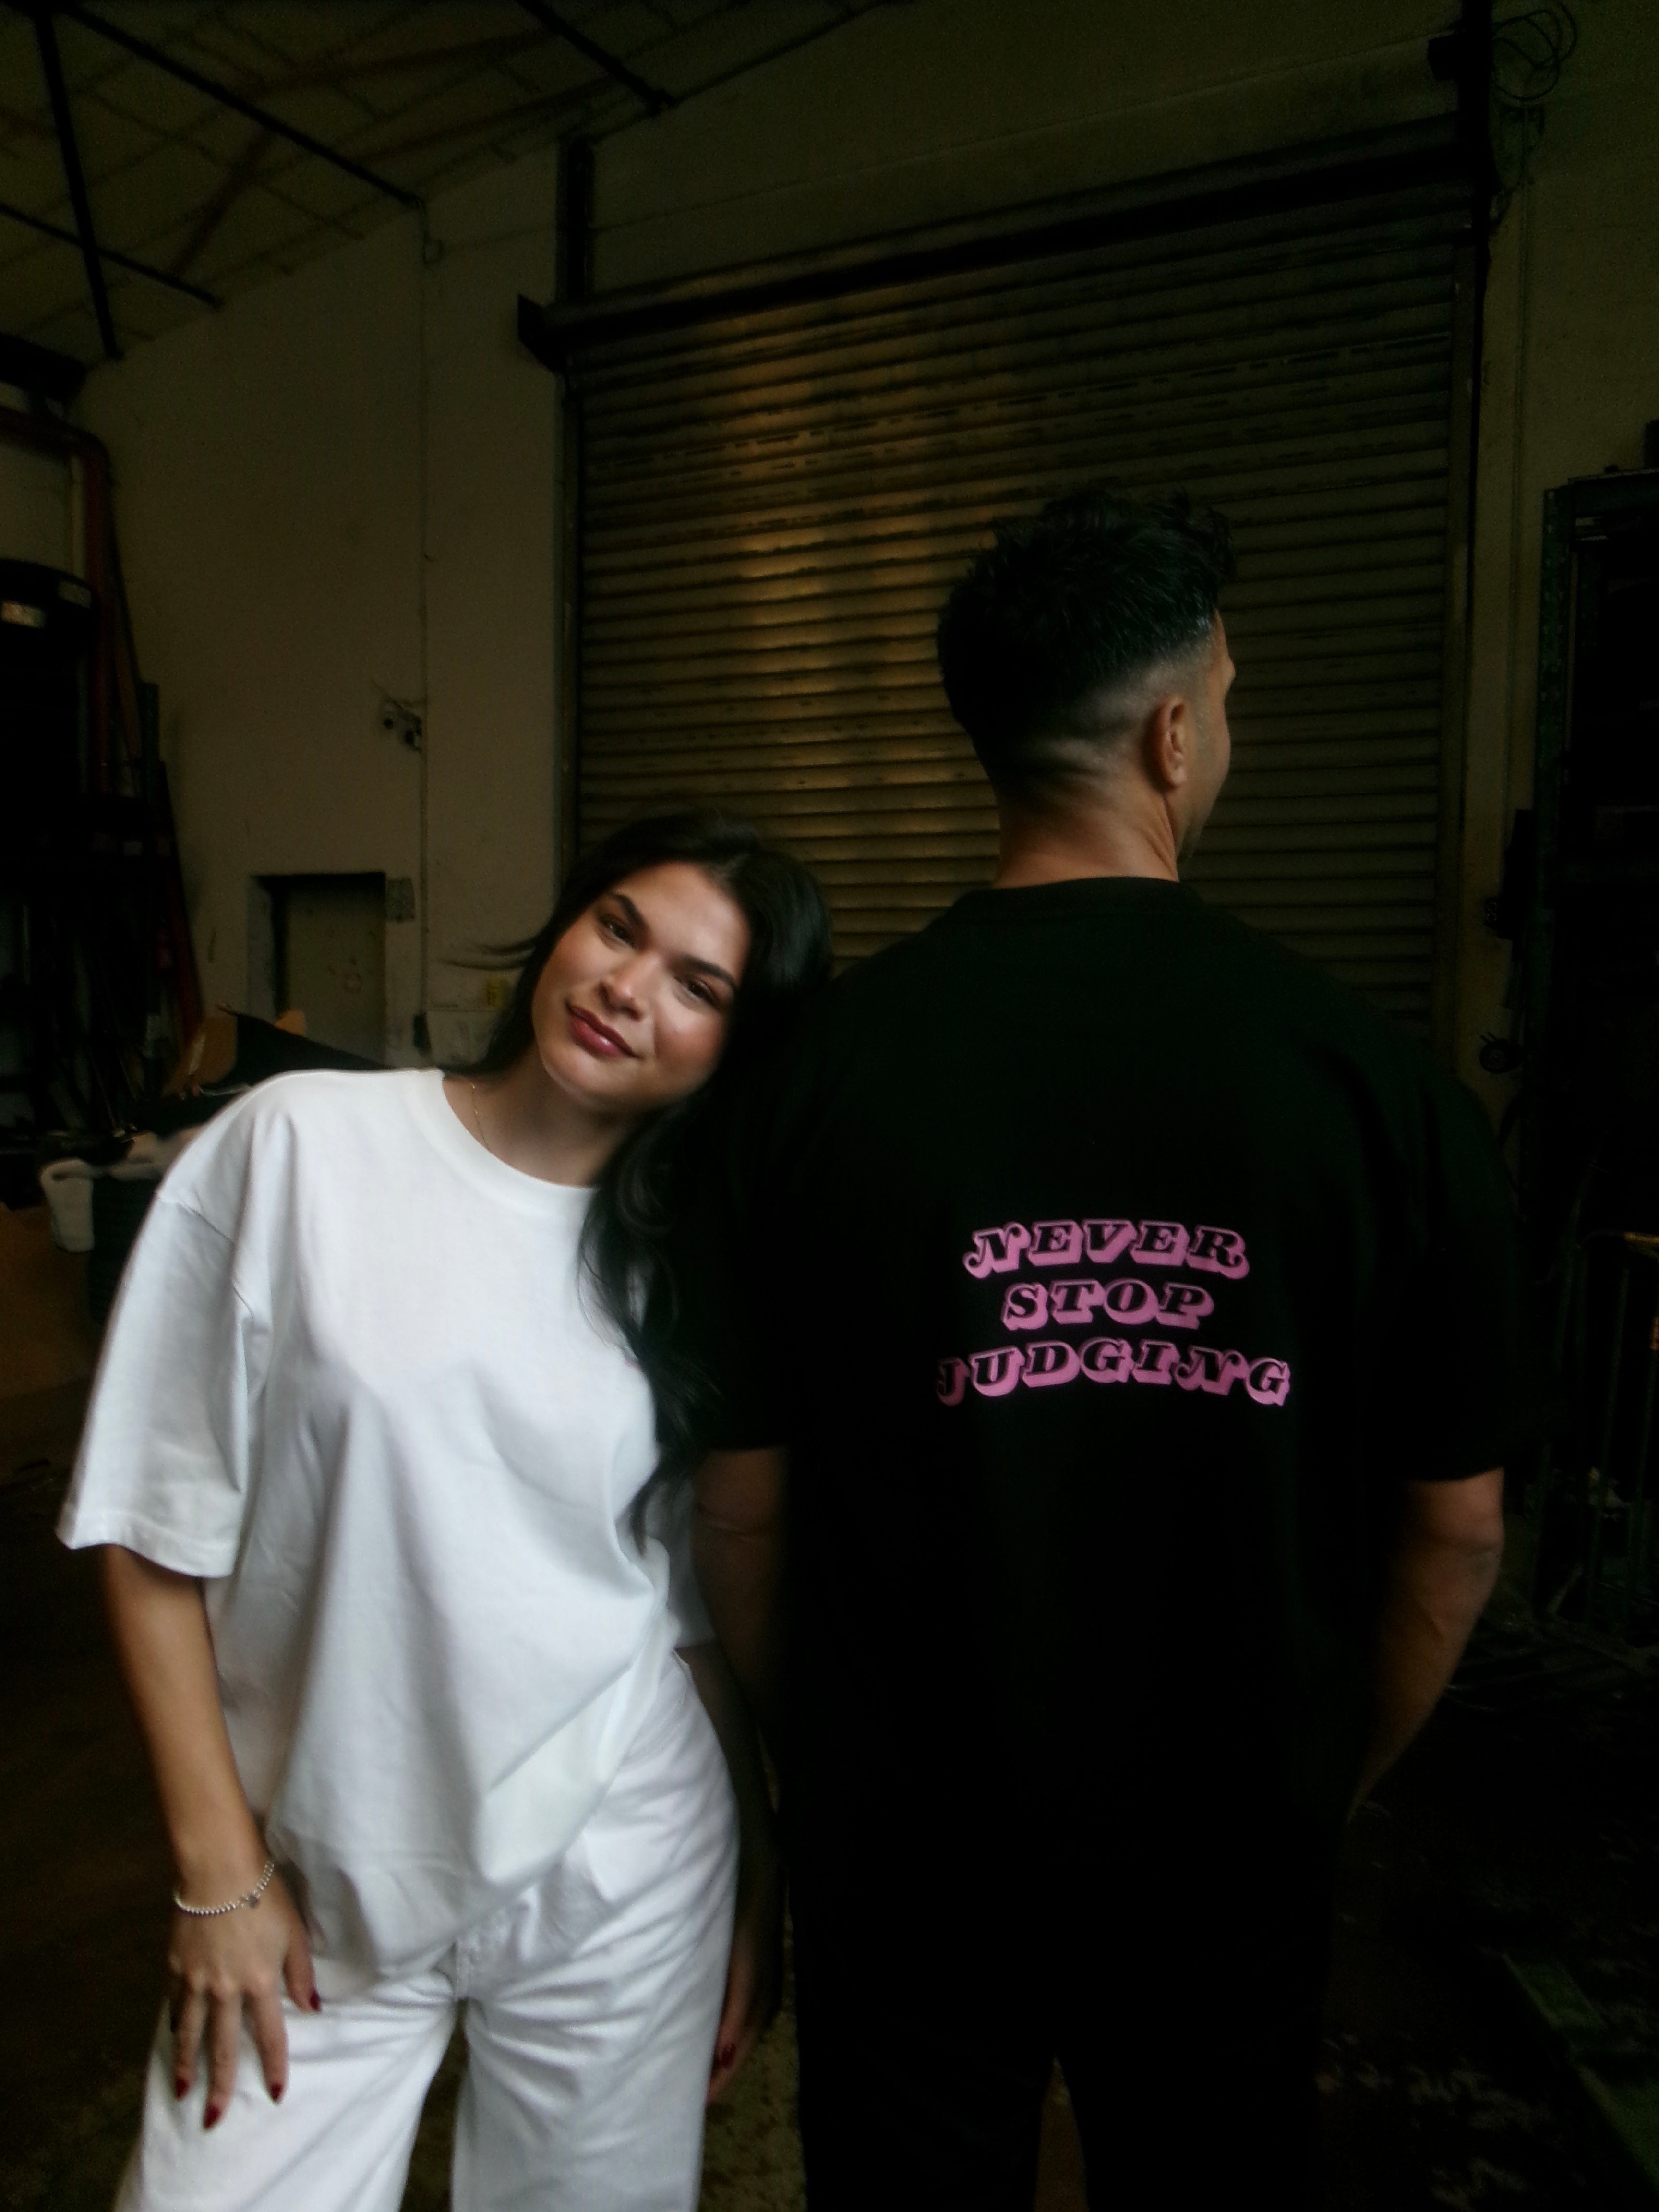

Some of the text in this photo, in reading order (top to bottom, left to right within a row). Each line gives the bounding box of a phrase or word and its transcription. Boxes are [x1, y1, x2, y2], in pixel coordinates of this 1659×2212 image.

[963, 1219, 1249, 1279] NEVER
[1001, 1278, 1214, 1330] STOP
[938, 1336, 1291, 1406] JUDGING
